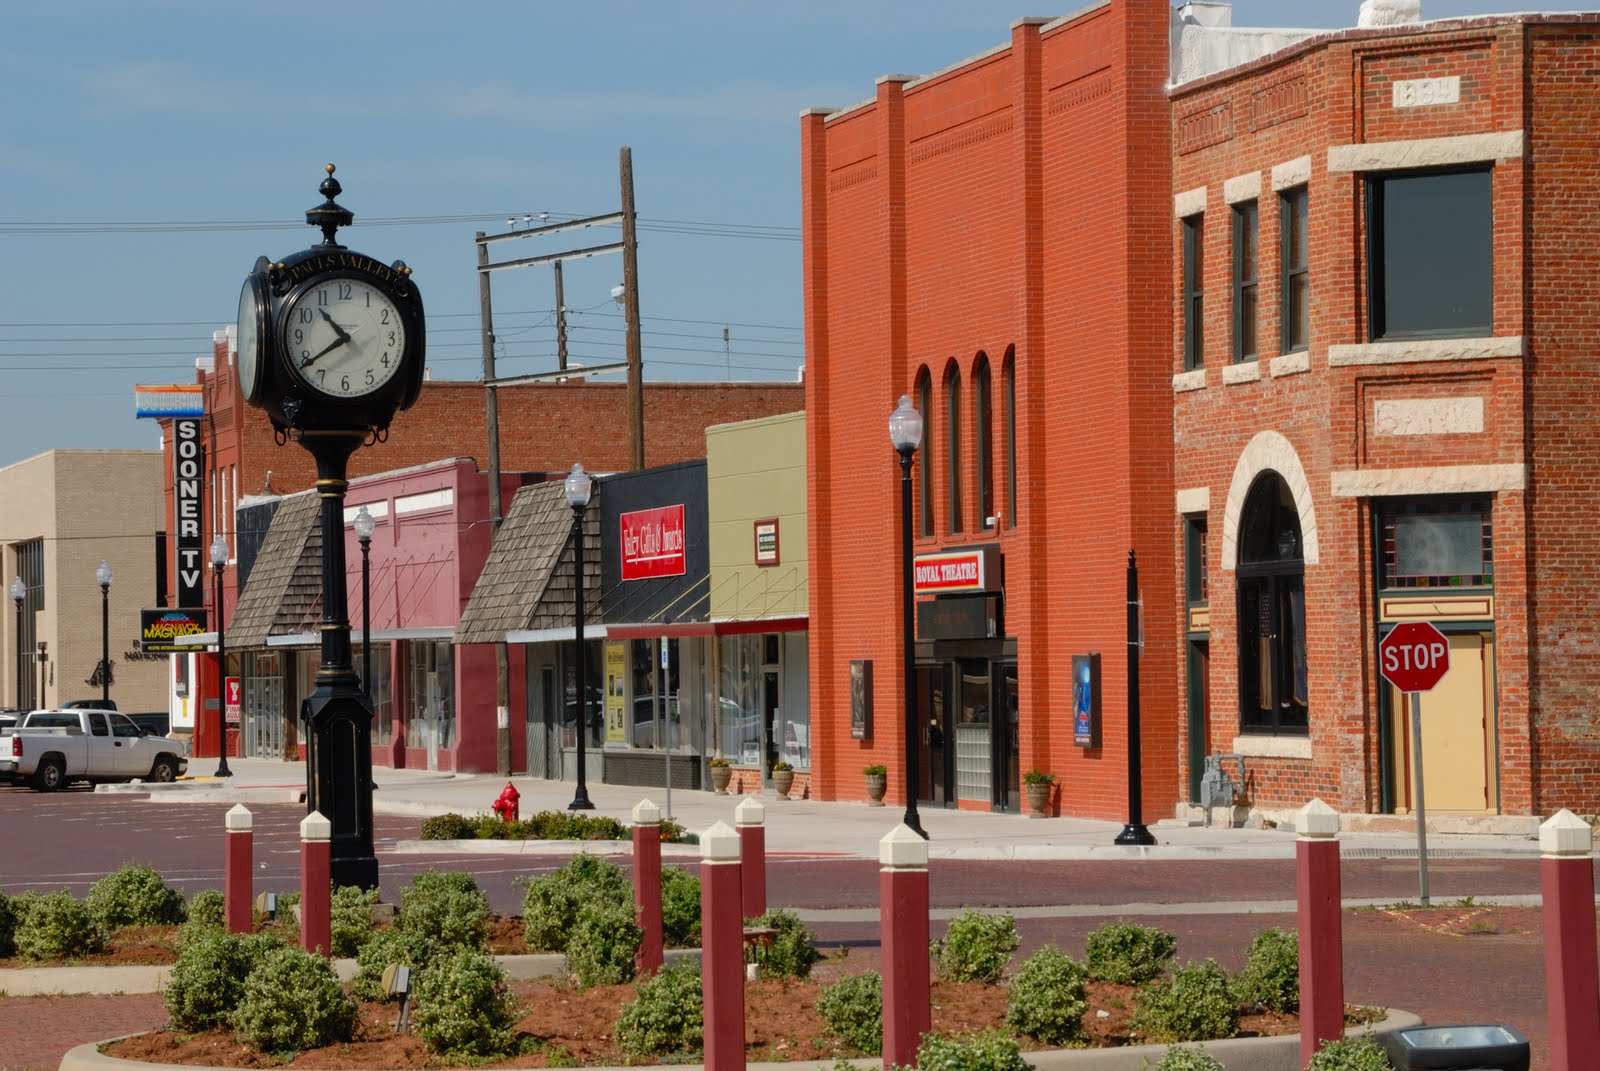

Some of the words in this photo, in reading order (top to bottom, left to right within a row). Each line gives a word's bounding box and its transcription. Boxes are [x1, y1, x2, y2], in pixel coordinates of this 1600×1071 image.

[291, 256, 336, 279] PAULS
[339, 254, 392, 281] VALLEY
[317, 290, 328, 306] 11
[338, 284, 352, 300] 12
[365, 292, 371, 308] 1
[300, 308, 313, 324] 10
[381, 309, 389, 325] 2
[295, 329, 303, 345] 9
[388, 331, 396, 347] 3
[302, 350, 310, 365] 8
[381, 352, 390, 368] 4
[316, 369, 326, 385] 7
[341, 375, 350, 392] 6
[365, 369, 374, 386] 5
[179, 421, 198, 538] SOONER
[623, 526, 640, 564] Valley
[181, 550, 200, 588] TV
[916, 565, 940, 583] ROYAL
[941, 562, 977, 581] THEATRE
[144, 628, 206, 639] MAGNAVOX
[1385, 642, 1445, 672] STOP
